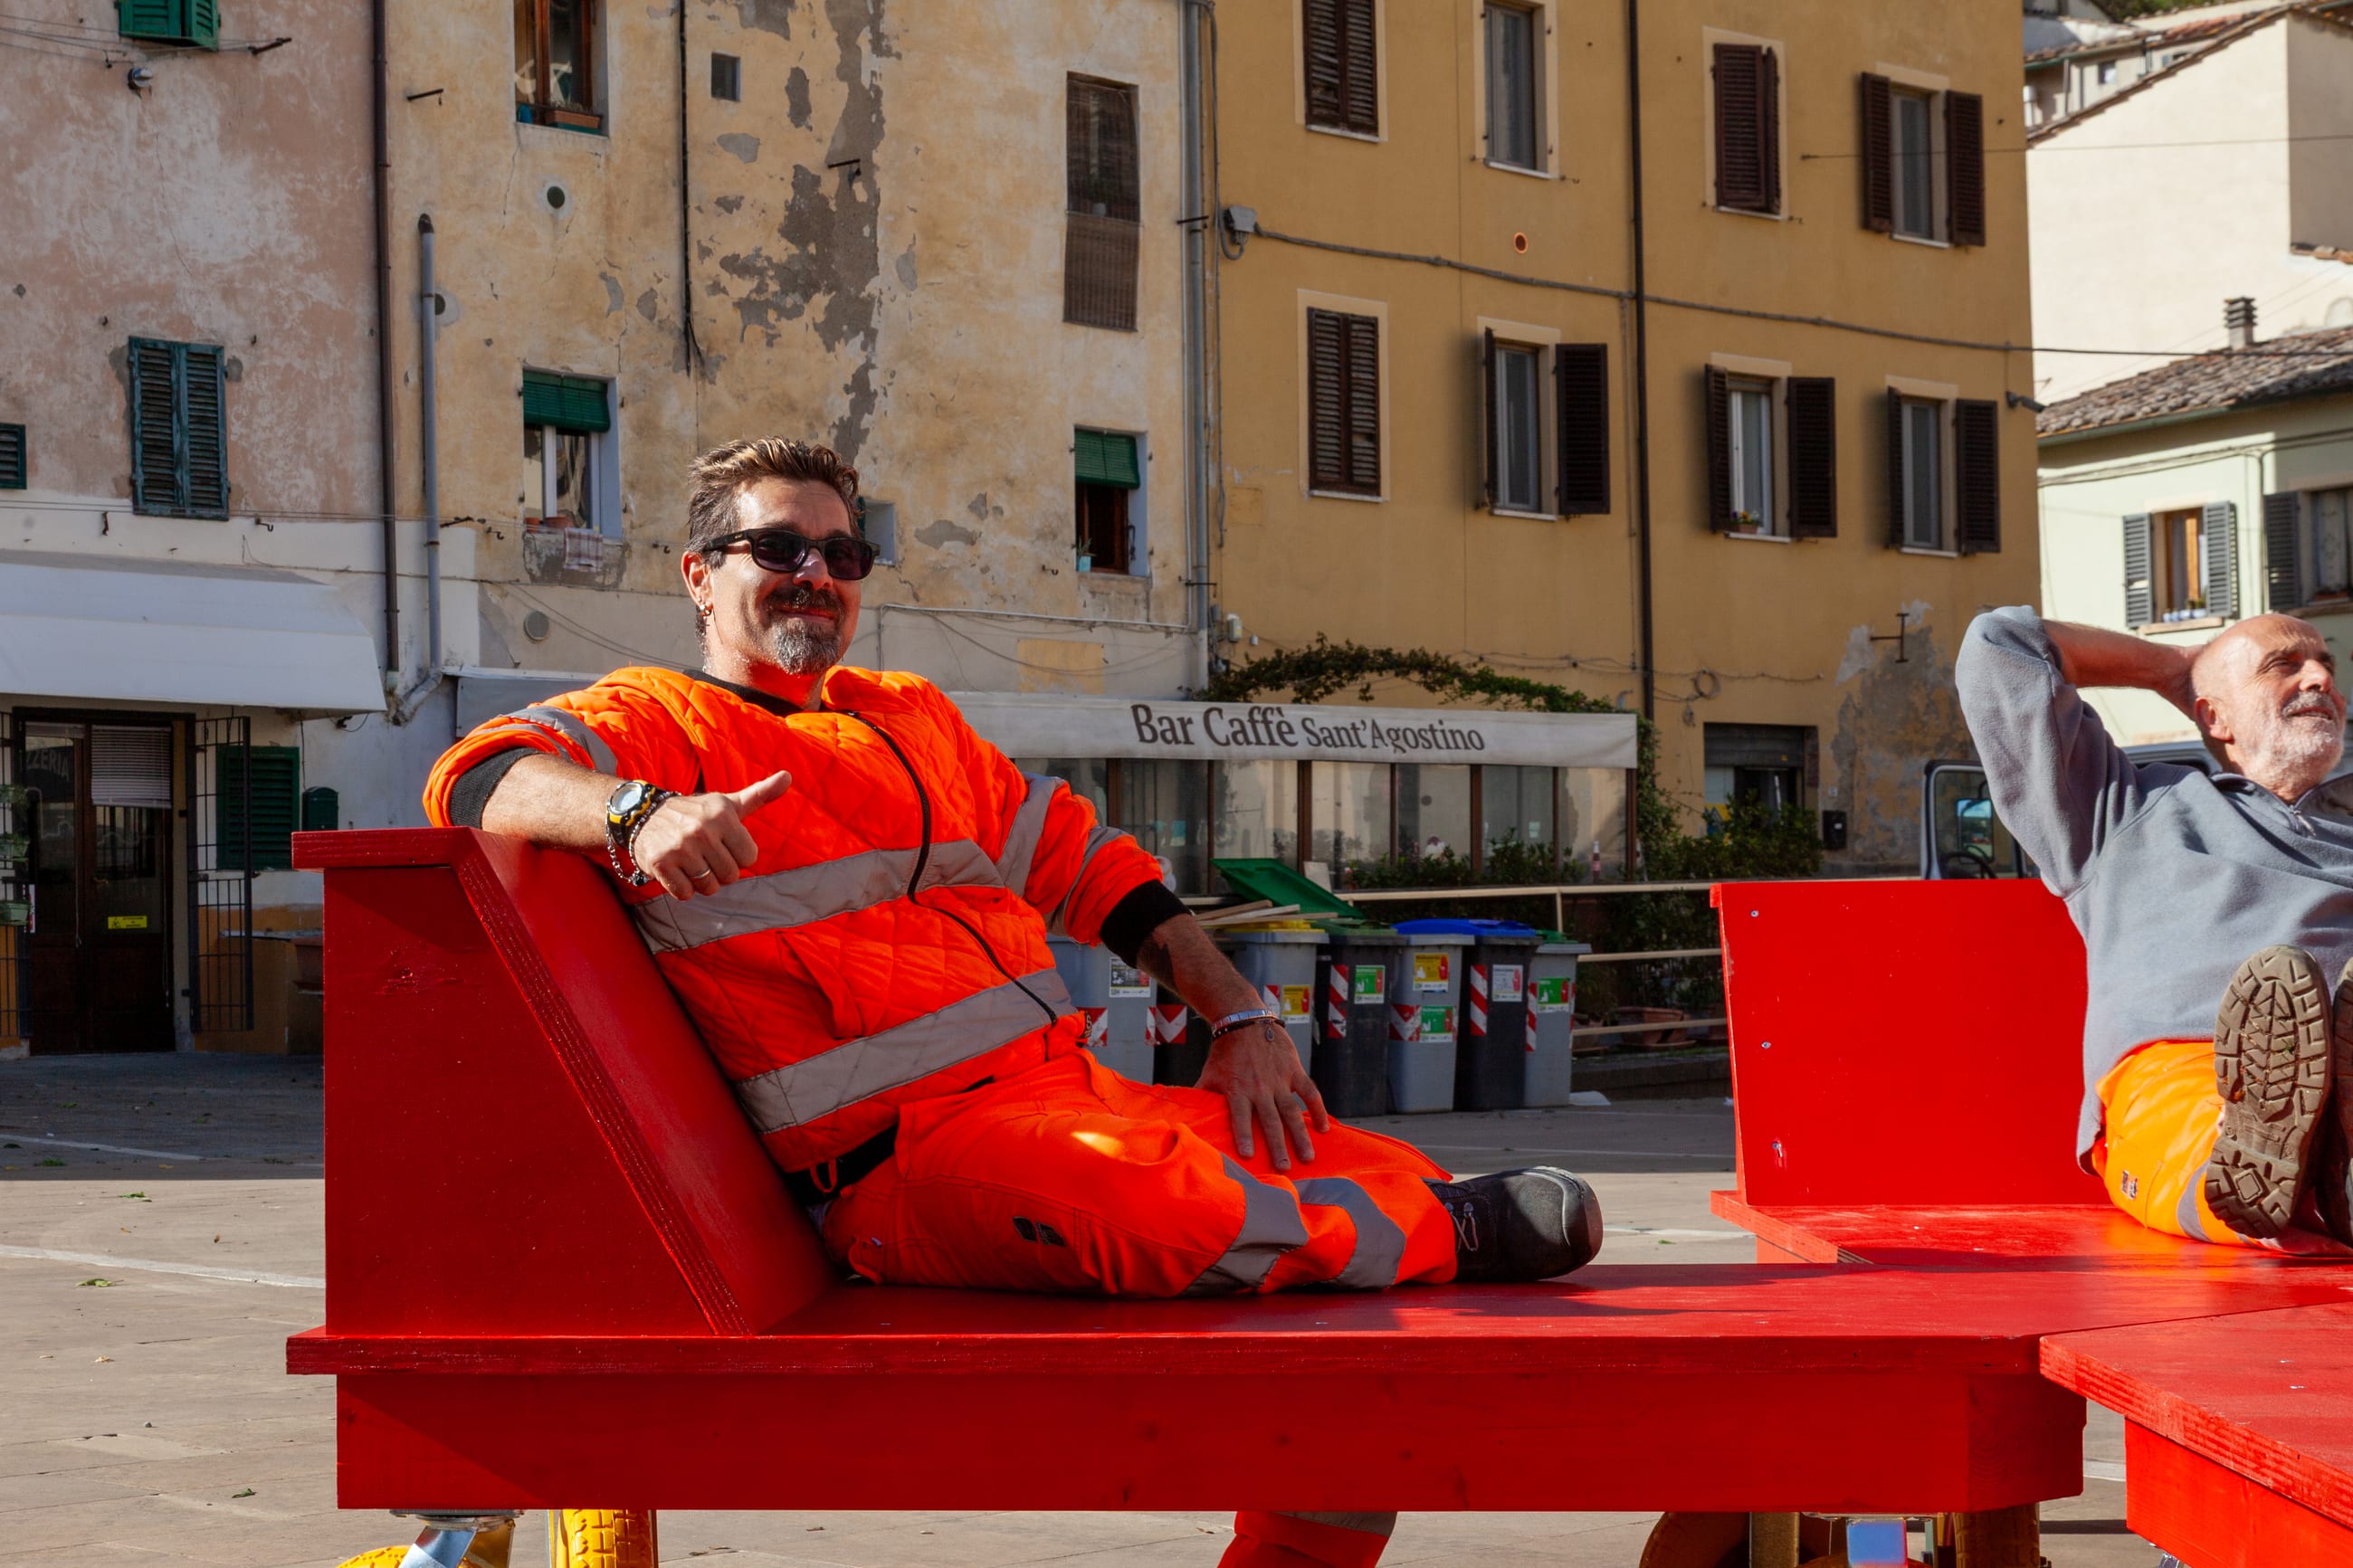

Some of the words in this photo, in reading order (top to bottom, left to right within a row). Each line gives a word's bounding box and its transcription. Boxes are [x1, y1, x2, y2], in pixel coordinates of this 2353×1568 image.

[1130, 704, 1195, 746] Bar
[1203, 705, 1300, 748] Caffè
[1301, 717, 1485, 755] Sant'Agostino
